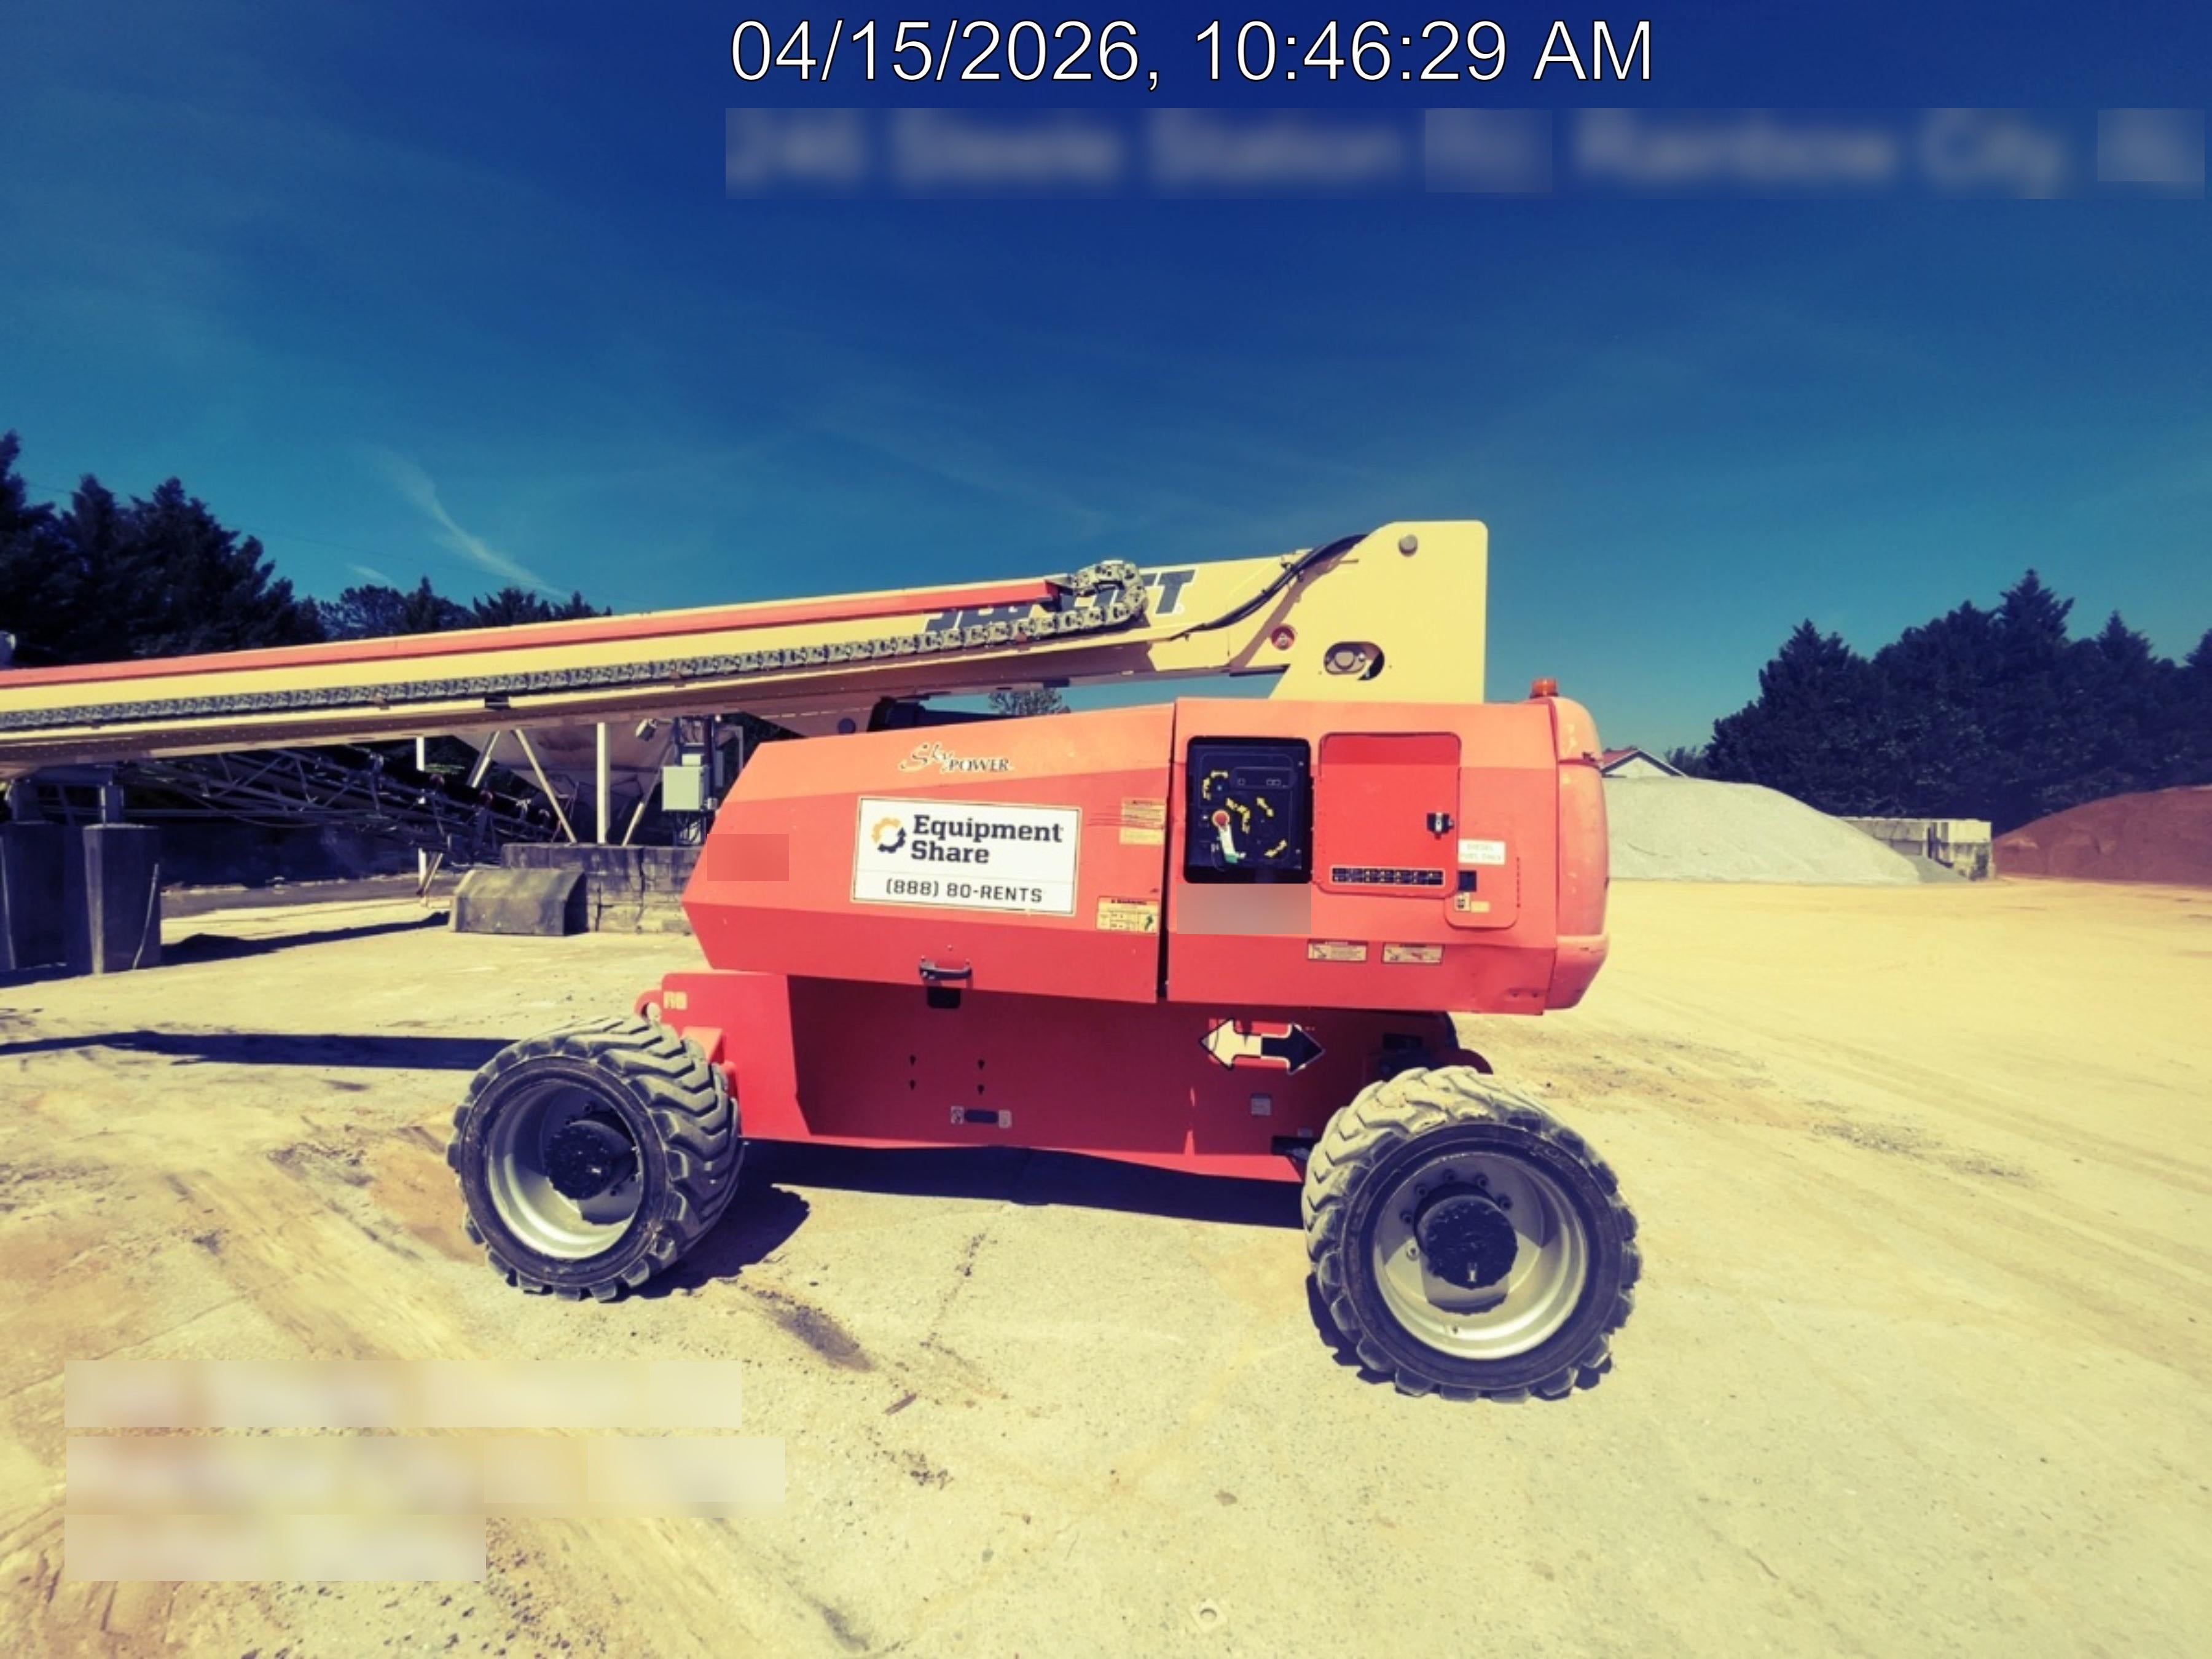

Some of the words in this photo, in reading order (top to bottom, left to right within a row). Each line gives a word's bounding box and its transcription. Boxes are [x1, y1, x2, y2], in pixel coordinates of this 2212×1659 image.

[912, 814, 1062, 842] Equipment
[911, 839, 989, 863] Share
[886, 878, 939, 897] (888)
[946, 882, 1043, 903] 80-RENTS
